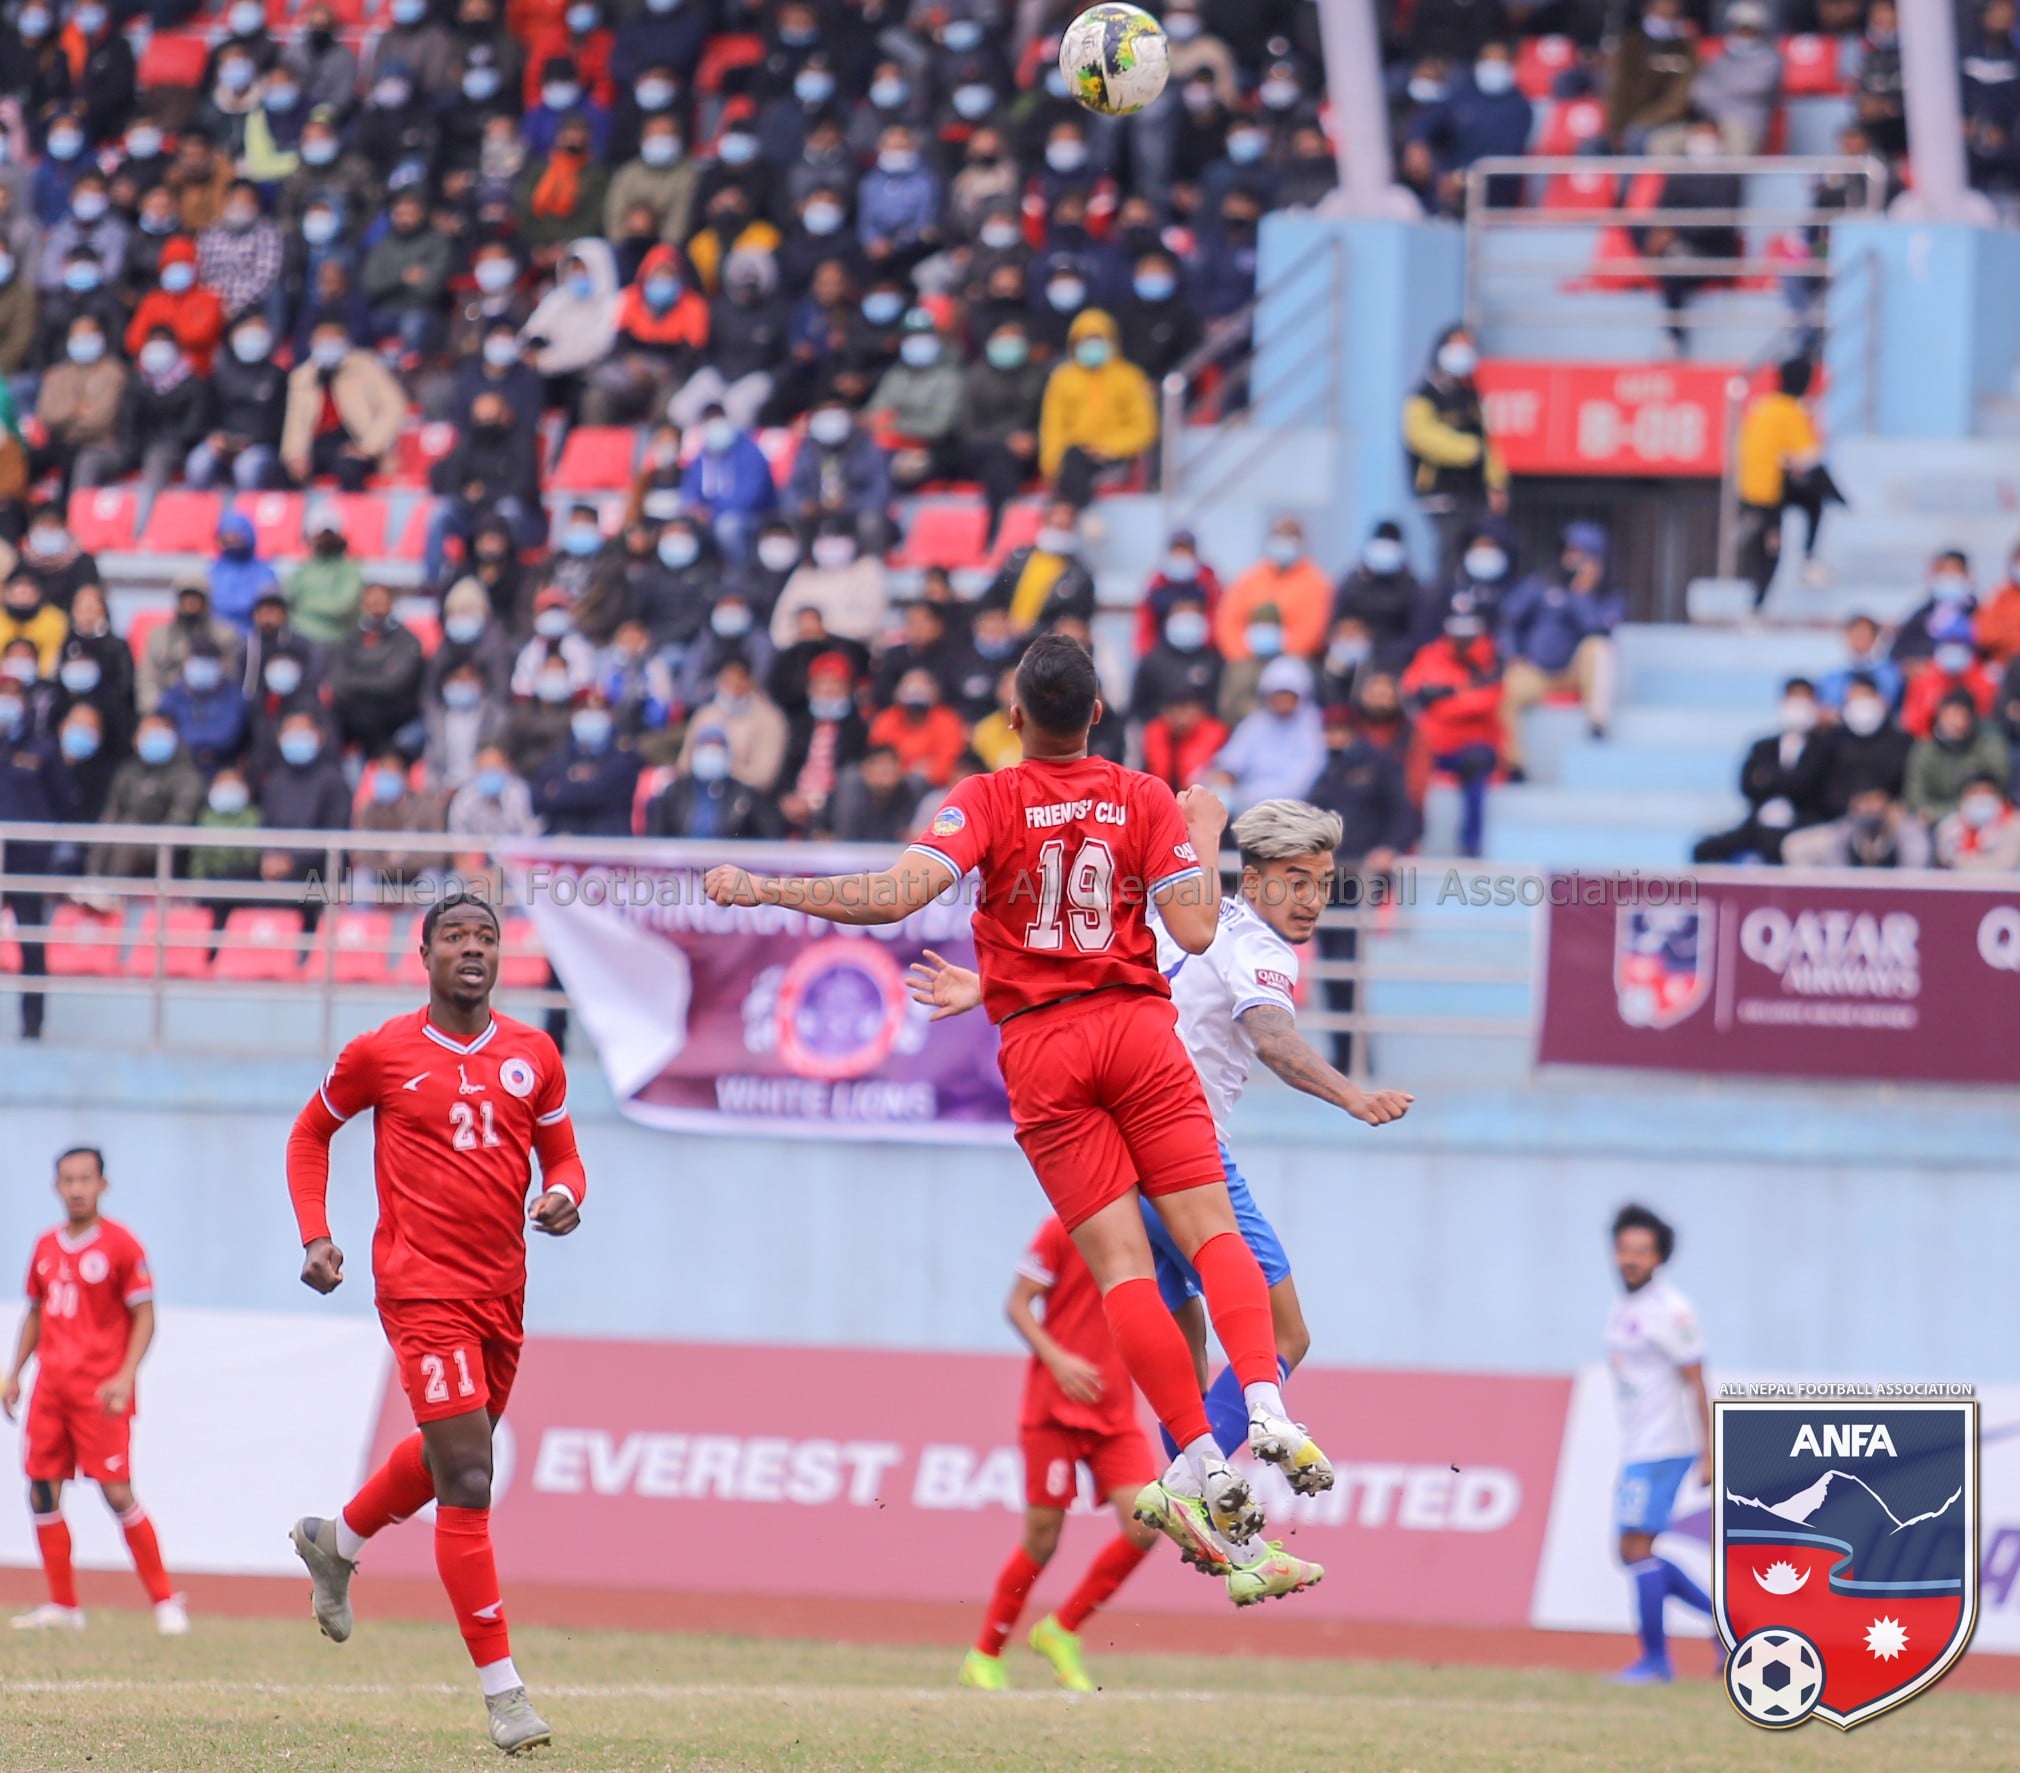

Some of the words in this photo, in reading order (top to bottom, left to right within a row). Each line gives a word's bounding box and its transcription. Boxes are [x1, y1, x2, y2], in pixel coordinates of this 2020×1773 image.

[1483, 391, 1538, 436] IT
[1095, 801, 1127, 827] CLU
[1024, 837, 1115, 953] 19
[1740, 906, 1921, 972] QATAR
[1977, 905, 2020, 973] Q
[449, 1101, 500, 1151] 21
[715, 1074, 828, 1117] WHITE
[829, 1079, 938, 1121] LIONS
[420, 1347, 476, 1404] 21
[532, 1427, 904, 1508] EVEREST
